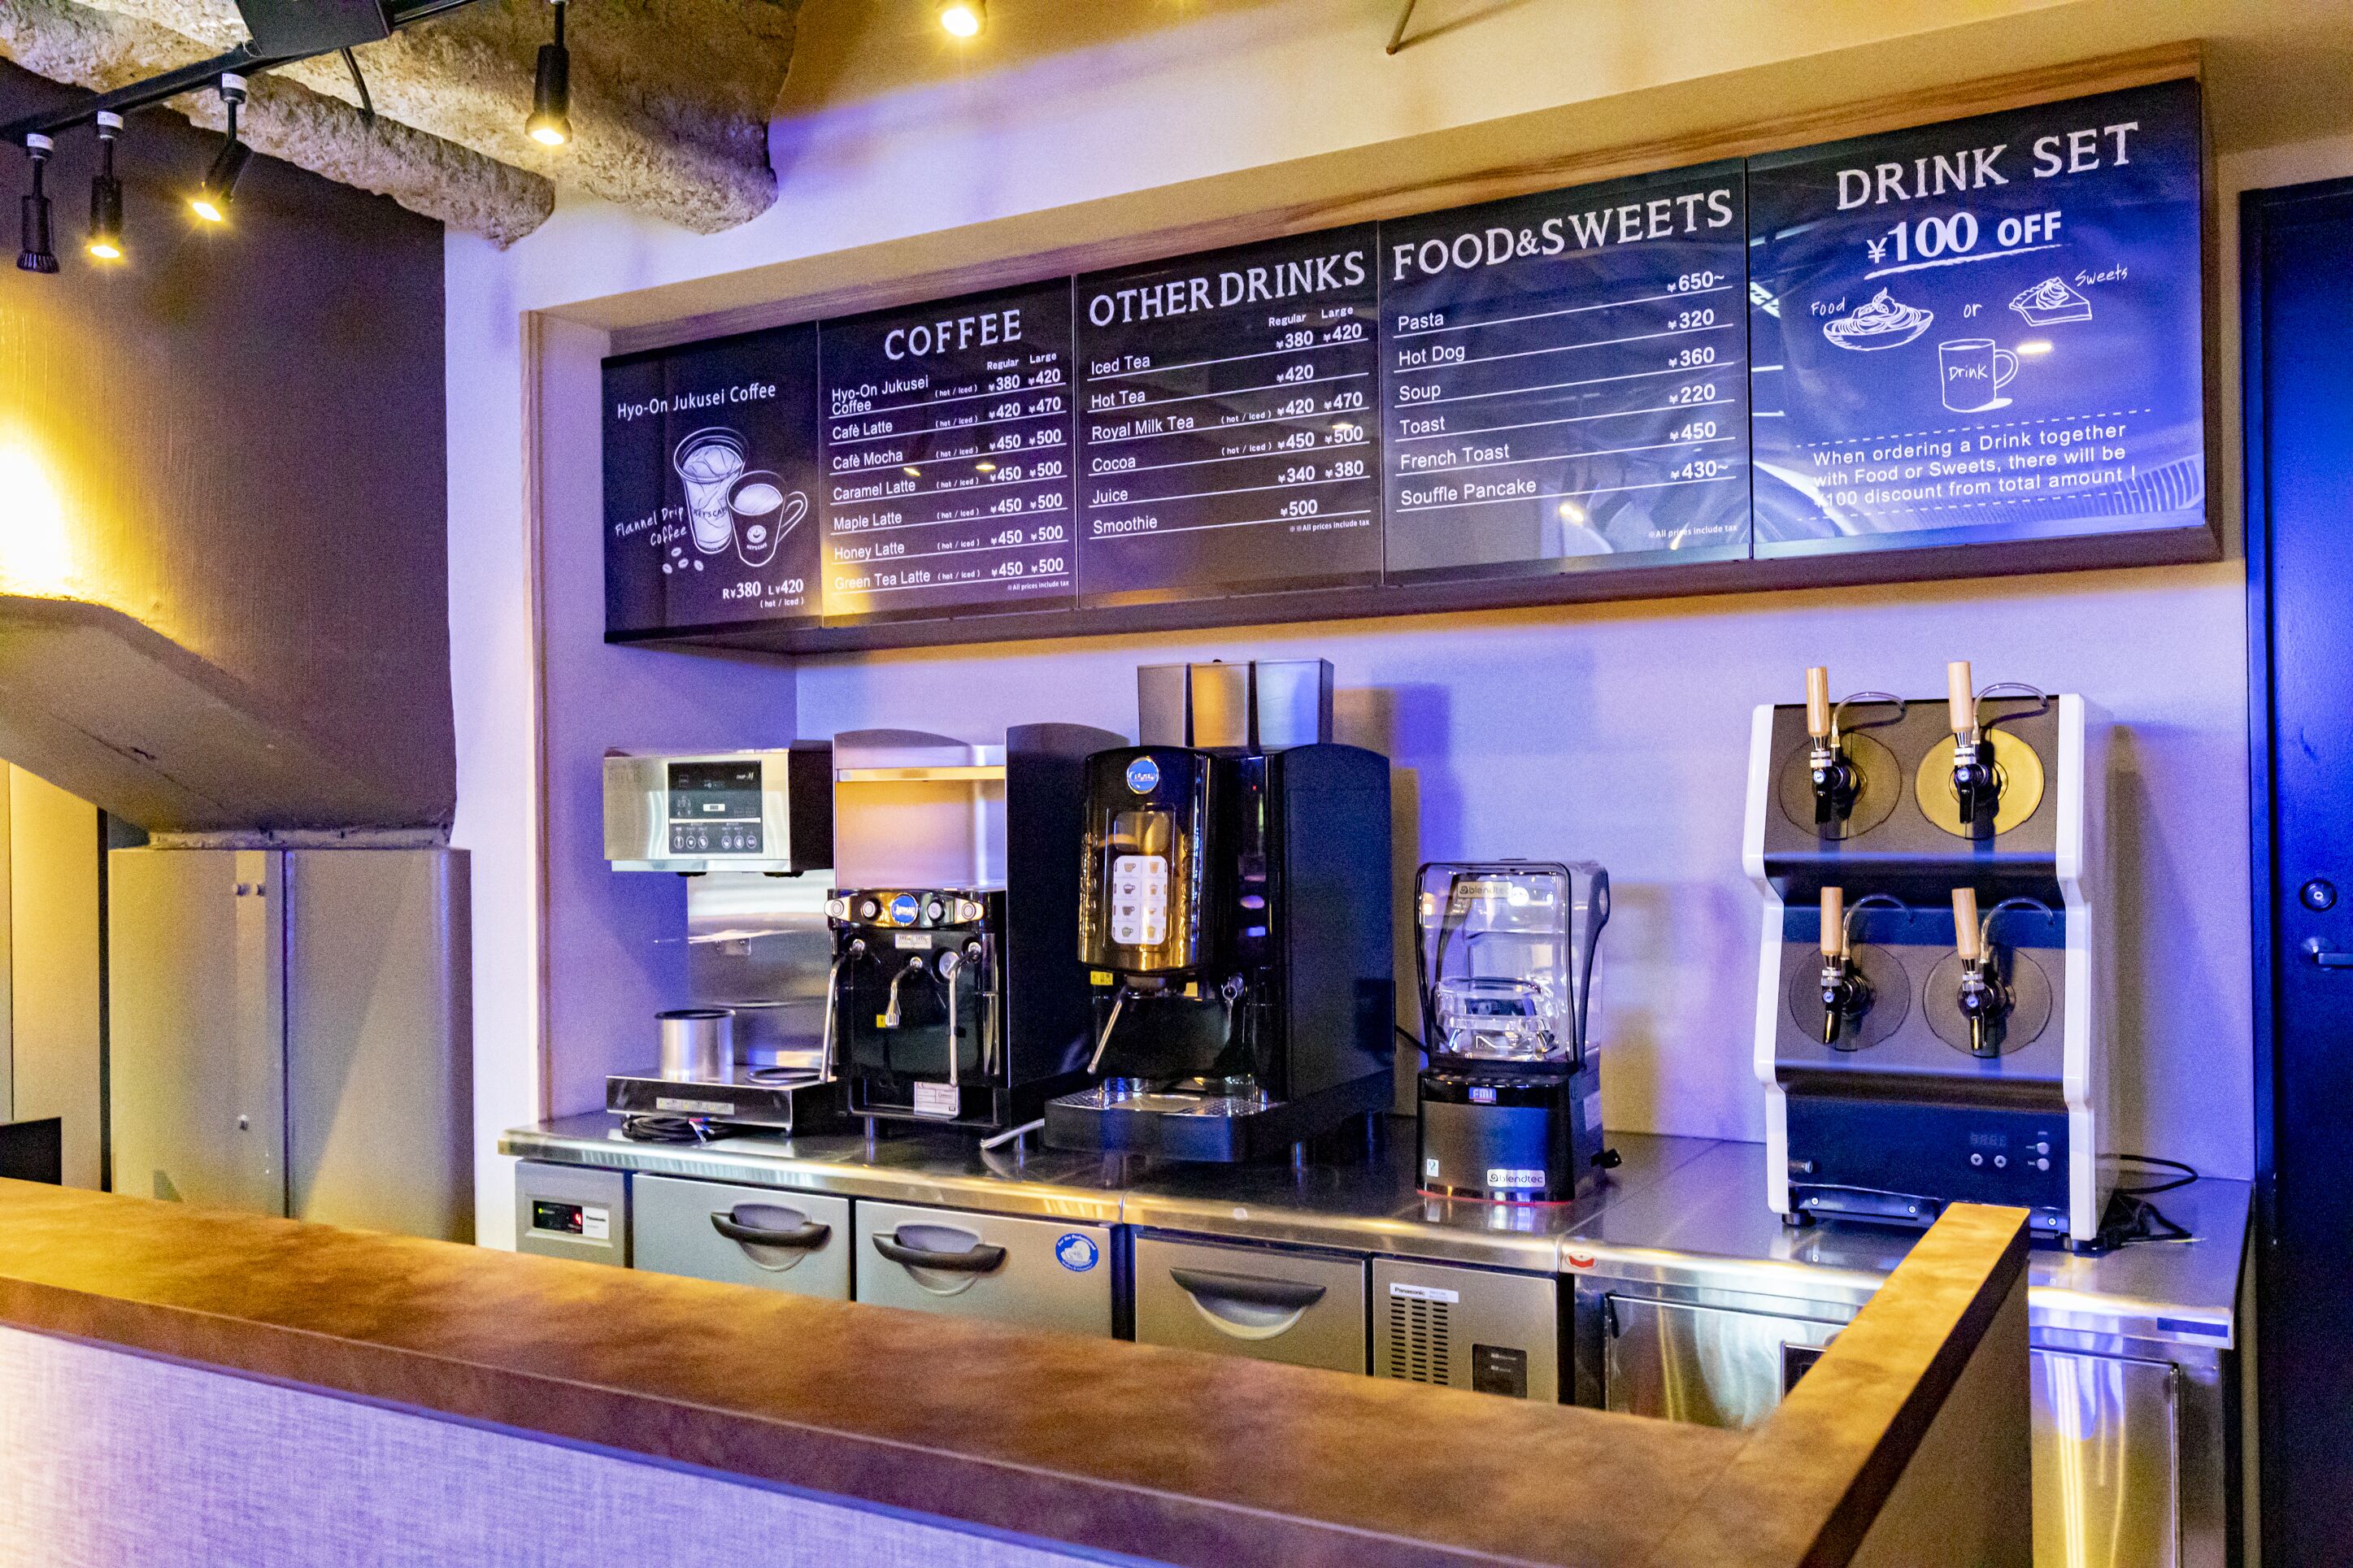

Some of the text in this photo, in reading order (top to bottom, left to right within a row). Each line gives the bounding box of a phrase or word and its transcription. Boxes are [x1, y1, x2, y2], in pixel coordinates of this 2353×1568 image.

[1837, 121, 2138, 211] DRINK SET
[1393, 189, 1733, 280] FOOD&SWEETS
[1867, 211, 2061, 264] ¥100 OFF
[1089, 250, 1366, 327] OTHER DRINKS
[2074, 263, 2128, 288] Sweets
[1268, 306, 1354, 327] Regular Large
[1398, 312, 1444, 332] Pasta
[1811, 298, 1846, 317] Food
[1963, 302, 1982, 319] or
[885, 310, 1022, 360] COFFEE
[1091, 324, 1362, 376] Iced Tea ¥380 ¥420
[1399, 309, 1715, 367] Hot Dog ¥320
[987, 352, 1057, 371] Regular Large
[1399, 346, 1716, 402] Soup ¥360
[1948, 363, 1989, 382] Drink
[618, 382, 776, 421] Hyo-On Jukusei Coffee
[832, 384, 877, 404] Hyo-On
[881, 375, 929, 396] Jukusei
[988, 374, 1020, 392] ¥380
[1028, 368, 1061, 385] ¥420
[1091, 364, 1314, 408] Hot Tea ¥420
[833, 399, 872, 416] Coffee
[863, 420, 893, 436] Latte
[989, 402, 1020, 419] ¥420
[1029, 397, 1061, 413] ¥470
[1092, 423, 1131, 442] Royal
[1135, 419, 1163, 437] Milk
[1168, 416, 1194, 431] Tea
[1277, 397, 1315, 416] ¥420
[1324, 391, 1363, 410] ¥470
[1399, 383, 1716, 436] Toast ¥220
[863, 450, 903, 466] Mocha
[989, 434, 1021, 451] ¥450
[1029, 428, 1062, 445] ¥500
[1092, 456, 1136, 472] Cocoa
[1277, 432, 1316, 450] ¥450
[1324, 426, 1364, 444] ¥500
[1401, 421, 1716, 471] French Toast ¥450
[1814, 423, 2126, 467] When ordering a Drink together
[833, 483, 882, 501] Caramel
[886, 480, 916, 495] Latte
[989, 466, 1022, 482] ¥450
[1029, 461, 1062, 478] ¥500
[1092, 460, 1364, 506] Juice ¥340 ¥380
[1814, 442, 2126, 487] with Food or Sweets, there will be
[1401, 484, 1458, 506] Souffle
[1464, 480, 1537, 501] Pancake
[1864, 484, 1942, 503] discount
[1948, 480, 1992, 497] from
[1999, 474, 2042, 493] total
[2048, 468, 2123, 488] amount
[615, 504, 685, 537] Flannel Drip
[833, 515, 868, 532] Maple
[872, 510, 902, 527] Latte
[990, 497, 1022, 514] ¥450
[1030, 493, 1063, 510] ¥500
[1093, 499, 1318, 536] Smoothie ¥500
[1313, 523, 1332, 532] prices
[1333, 519, 1357, 528] include
[650, 525, 687, 547] Coffee
[834, 545, 871, 560] Honey
[875, 541, 905, 557] Latte
[990, 529, 1023, 545] ¥450
[1031, 525, 1063, 542] ¥500
[834, 575, 871, 591] Green
[874, 572, 897, 588] Tea
[901, 569, 931, 584] Latte
[991, 561, 1024, 578] ¥450
[1031, 558, 1064, 574] ¥500
[1021, 583, 1037, 592] prices
[1039, 580, 1059, 589] include
[1394, 1287, 1425, 1297] Panasonic
